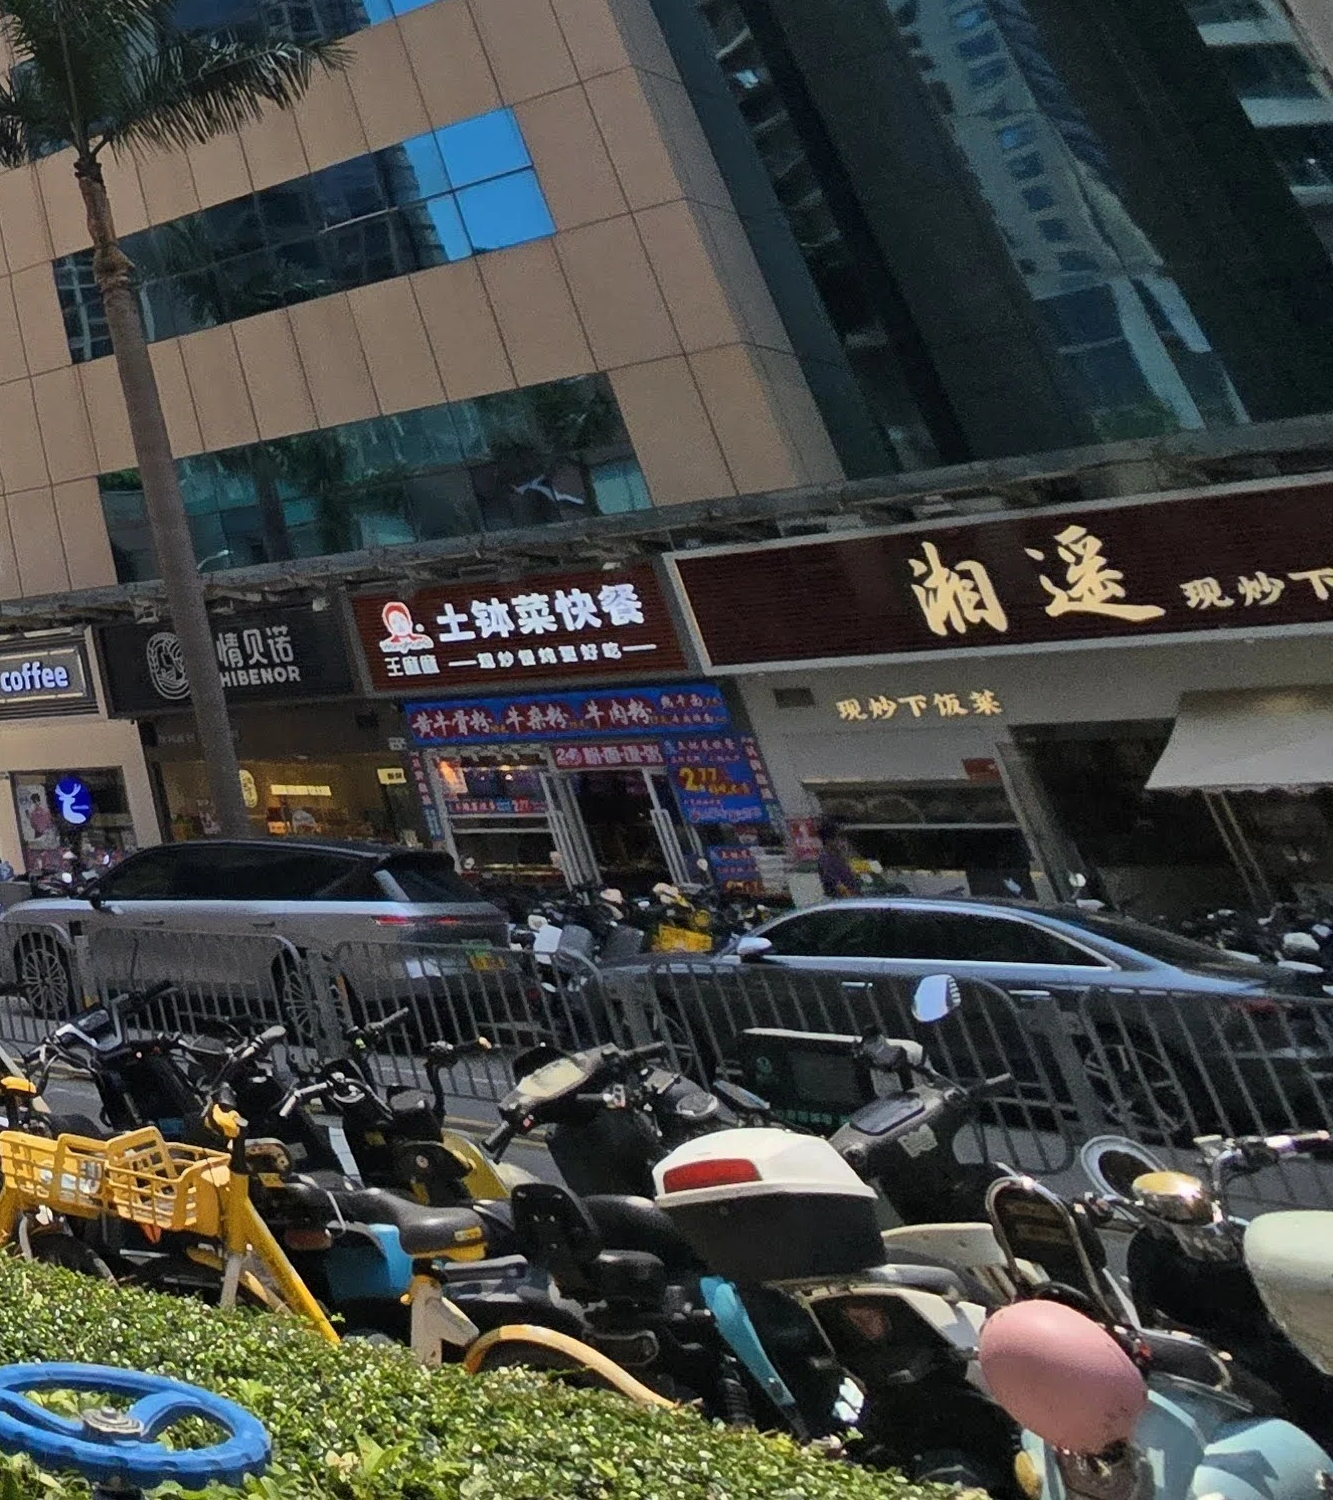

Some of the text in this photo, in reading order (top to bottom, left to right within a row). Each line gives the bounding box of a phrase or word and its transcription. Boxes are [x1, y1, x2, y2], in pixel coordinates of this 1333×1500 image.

[436, 583, 645, 642] 土钵菜快餐
[0, 661, 69, 692] coffee
[584, 698, 653, 730] 牛肉粉
[836, 689, 1003, 723] 现炒下饭菜
